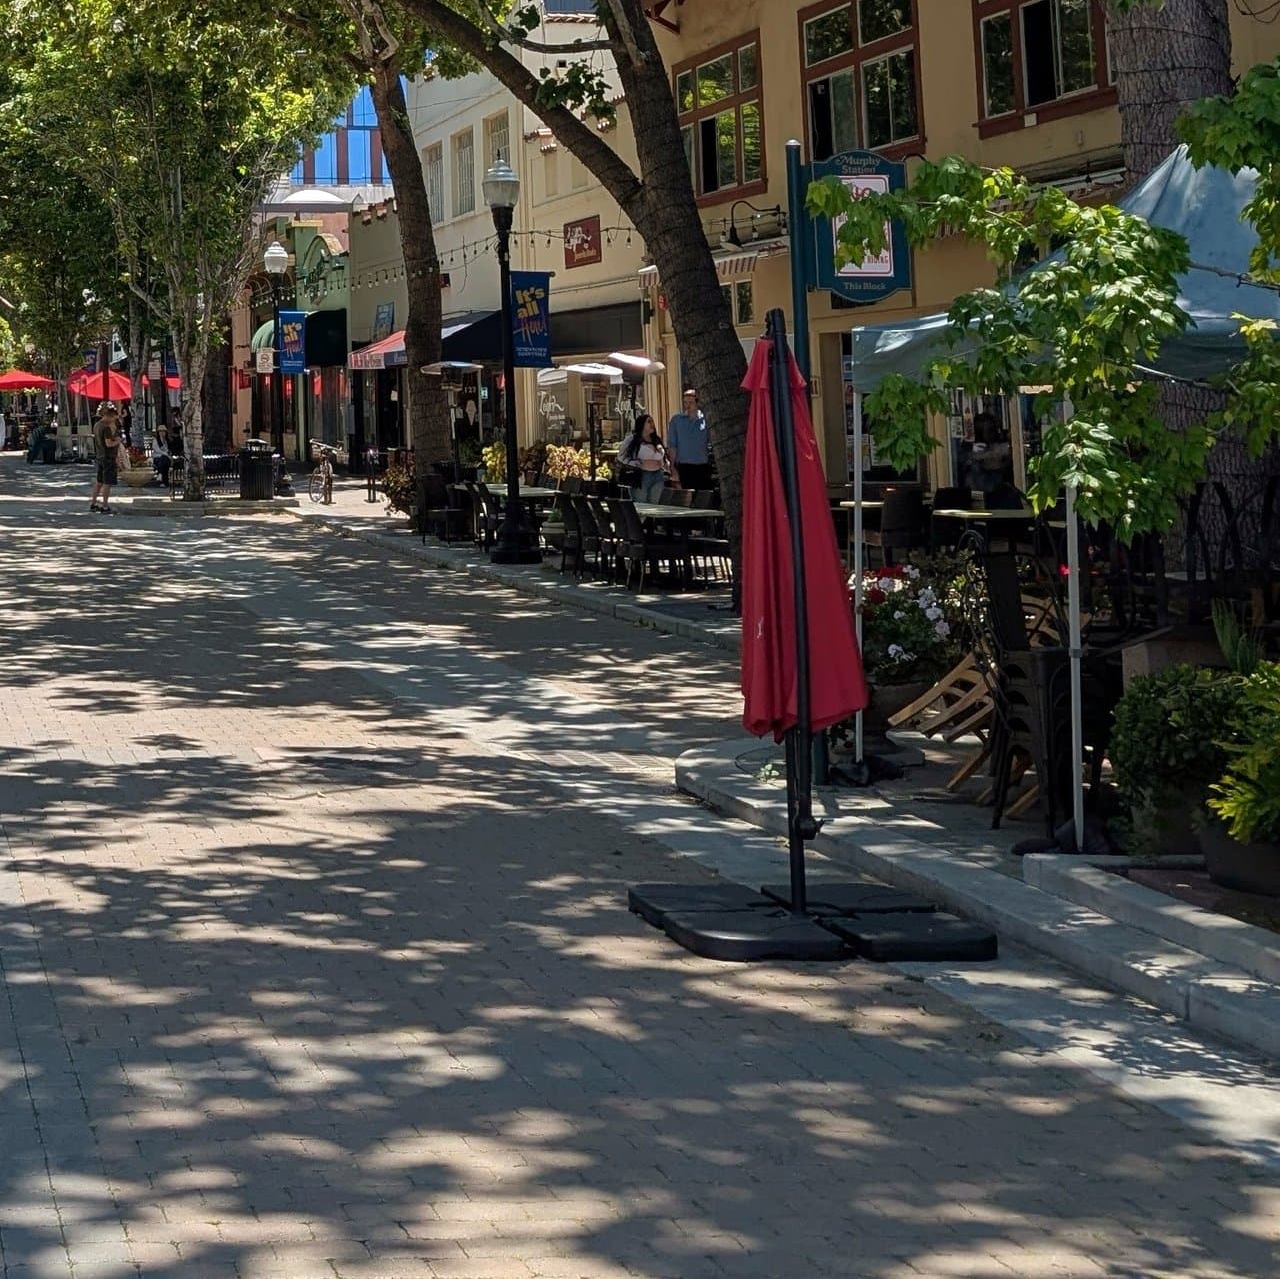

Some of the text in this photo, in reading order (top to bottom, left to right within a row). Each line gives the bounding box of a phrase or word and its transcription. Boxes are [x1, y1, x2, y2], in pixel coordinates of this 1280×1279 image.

[835, 155, 881, 167] Murphy
[841, 165, 876, 174] Station
[843, 282, 887, 290] This Block
[515, 287, 545, 305] It's
[517, 300, 540, 318] all
